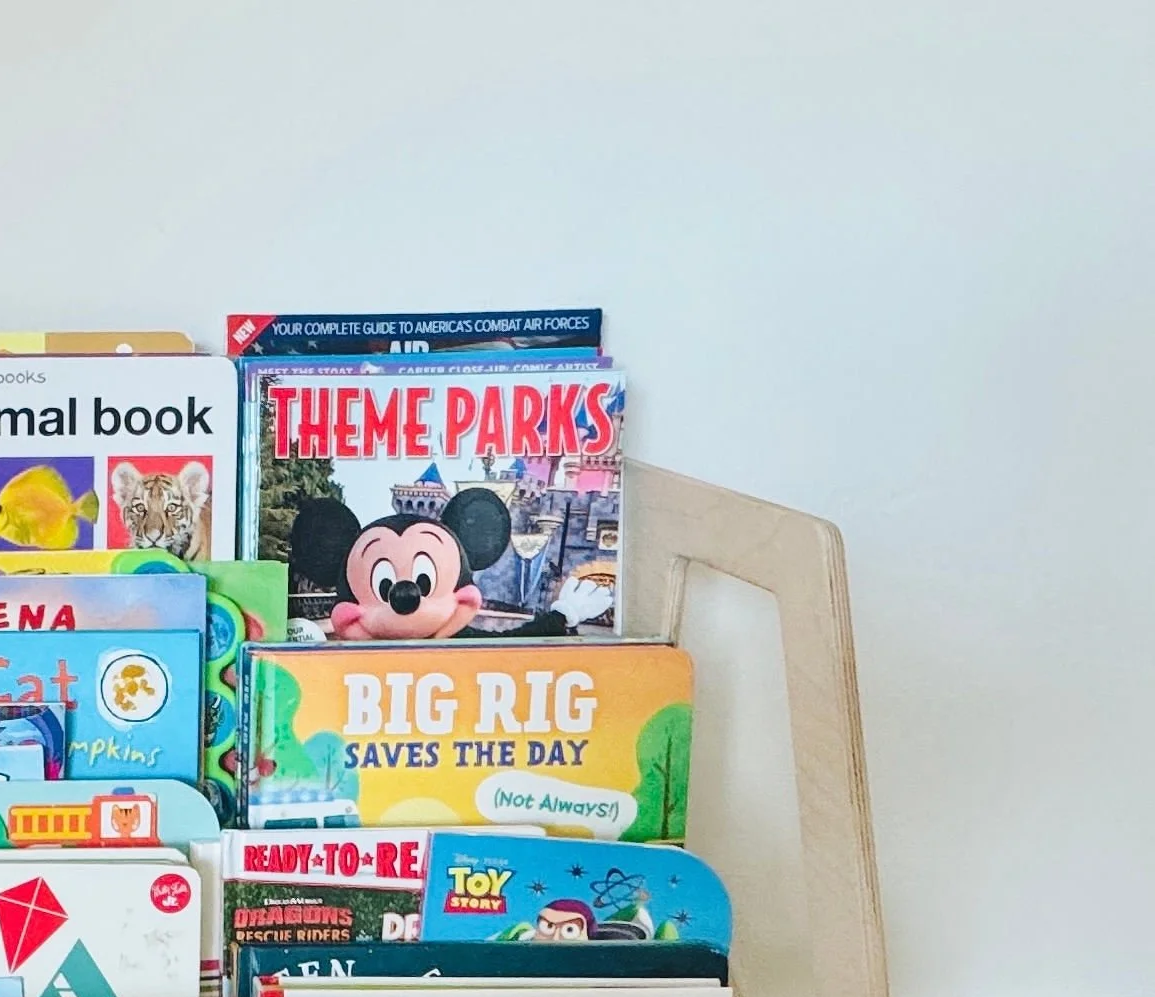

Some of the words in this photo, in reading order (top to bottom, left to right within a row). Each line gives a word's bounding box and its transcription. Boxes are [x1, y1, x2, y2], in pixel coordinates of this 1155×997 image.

[232, 319, 256, 345] NEW
[272, 323, 302, 335] YOUR
[304, 322, 360, 335] COMPLETE
[363, 322, 396, 334] GUIDE
[399, 321, 413, 333] TO
[415, 320, 472, 334] AMERICA'S
[475, 318, 522, 332] COMBAT
[524, 317, 542, 331] AIR
[544, 316, 590, 330] FORCES
[94, 396, 214, 436] book
[269, 387, 434, 459] THEME
[446, 382, 615, 459] PARKS
[344, 671, 458, 736] BIG
[474, 670, 597, 734] RIG
[68, 736, 164, 768] mpkins
[344, 741, 439, 769] SAVES
[453, 740, 516, 767] THE
[527, 739, 589, 767] DAY
[494, 786, 535, 811] (Not
[540, 791, 621, 824] Always!)
[244, 843, 314, 874] READY
[323, 842, 360, 877] TO
[376, 841, 424, 880] RE
[448, 866, 513, 897] TOY
[234, 905, 353, 929] DRAGONS
[450, 896, 503, 911] STORY
[296, 929, 350, 941] RIDERS
